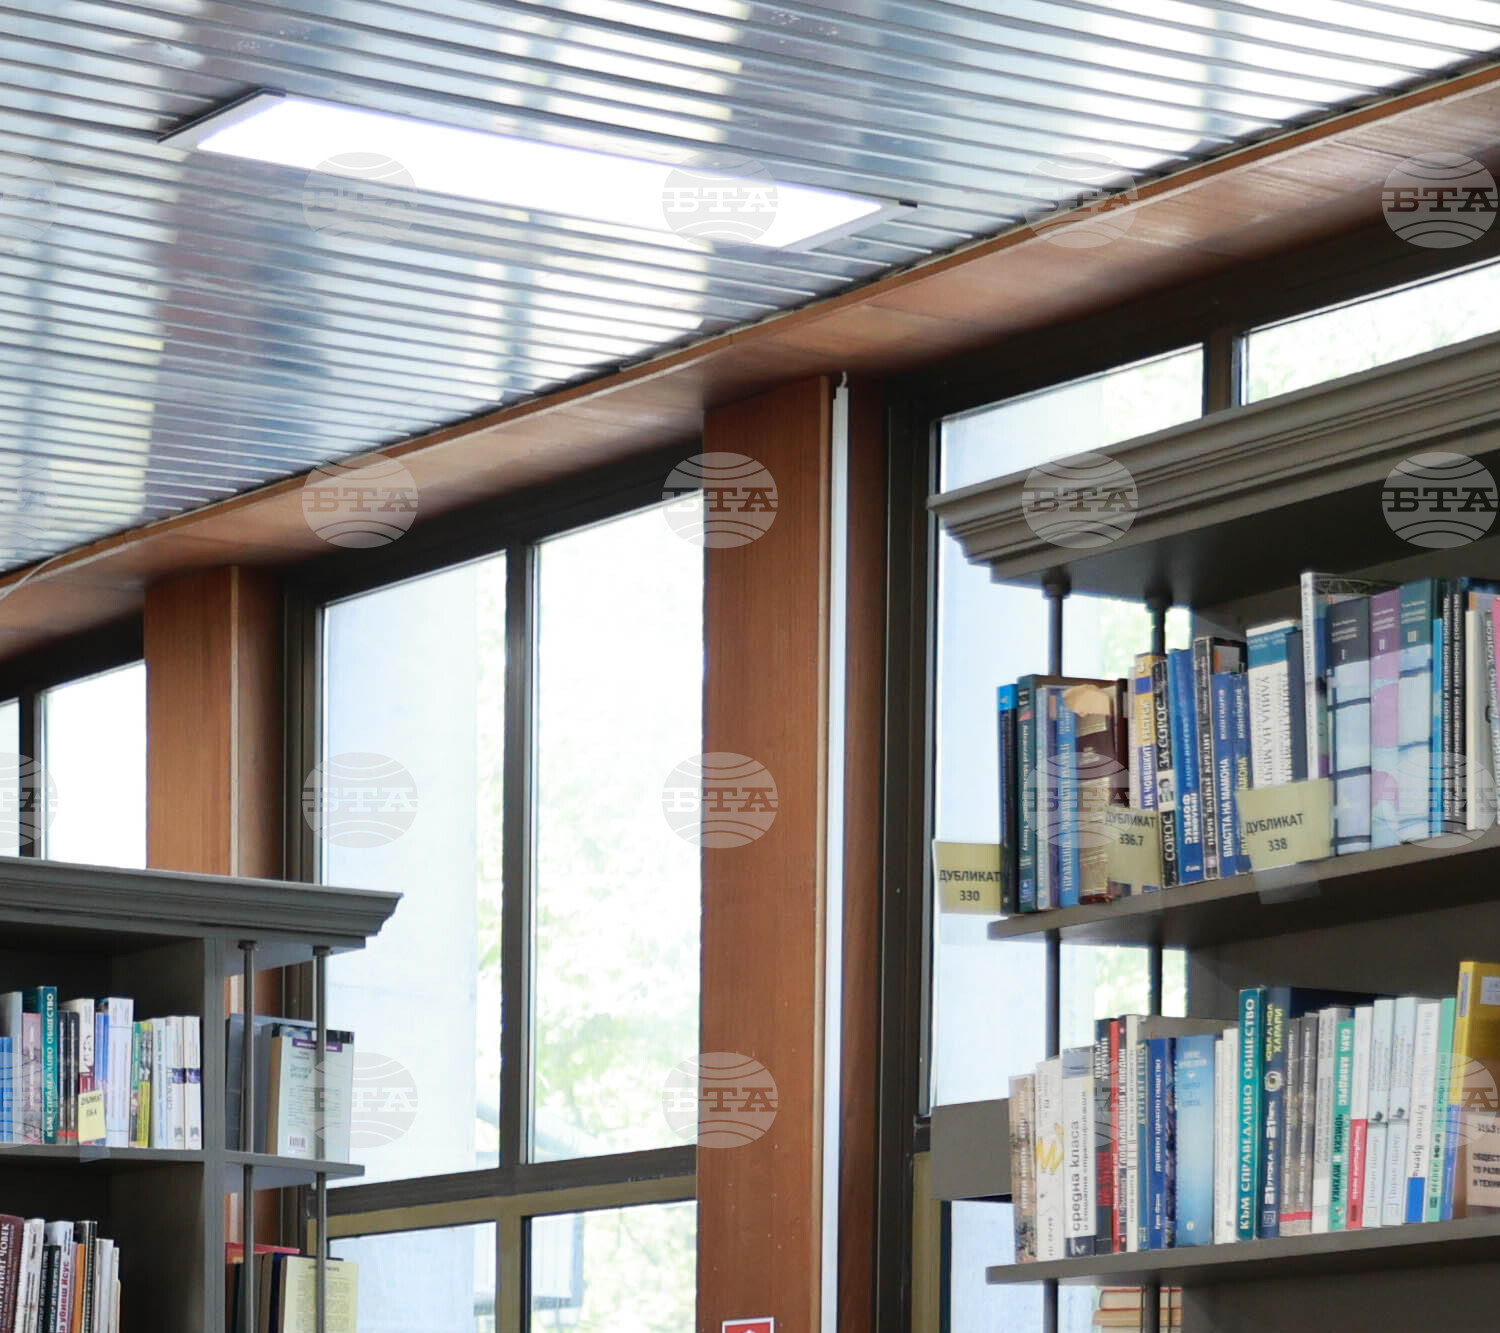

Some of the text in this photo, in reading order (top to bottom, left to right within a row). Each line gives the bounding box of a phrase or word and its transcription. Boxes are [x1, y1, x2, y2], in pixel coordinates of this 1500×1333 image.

[1245, 812, 1304, 834] ДУБЛИКАТ
[1268, 837, 1288, 852] 338
[939, 868, 1001, 883] ДУБЛИКАТ
[959, 889, 980, 902] 330
[1239, 997, 1256, 1231] КЪМ СПРАВЕДЛИВО ОБЩЕСТВО
